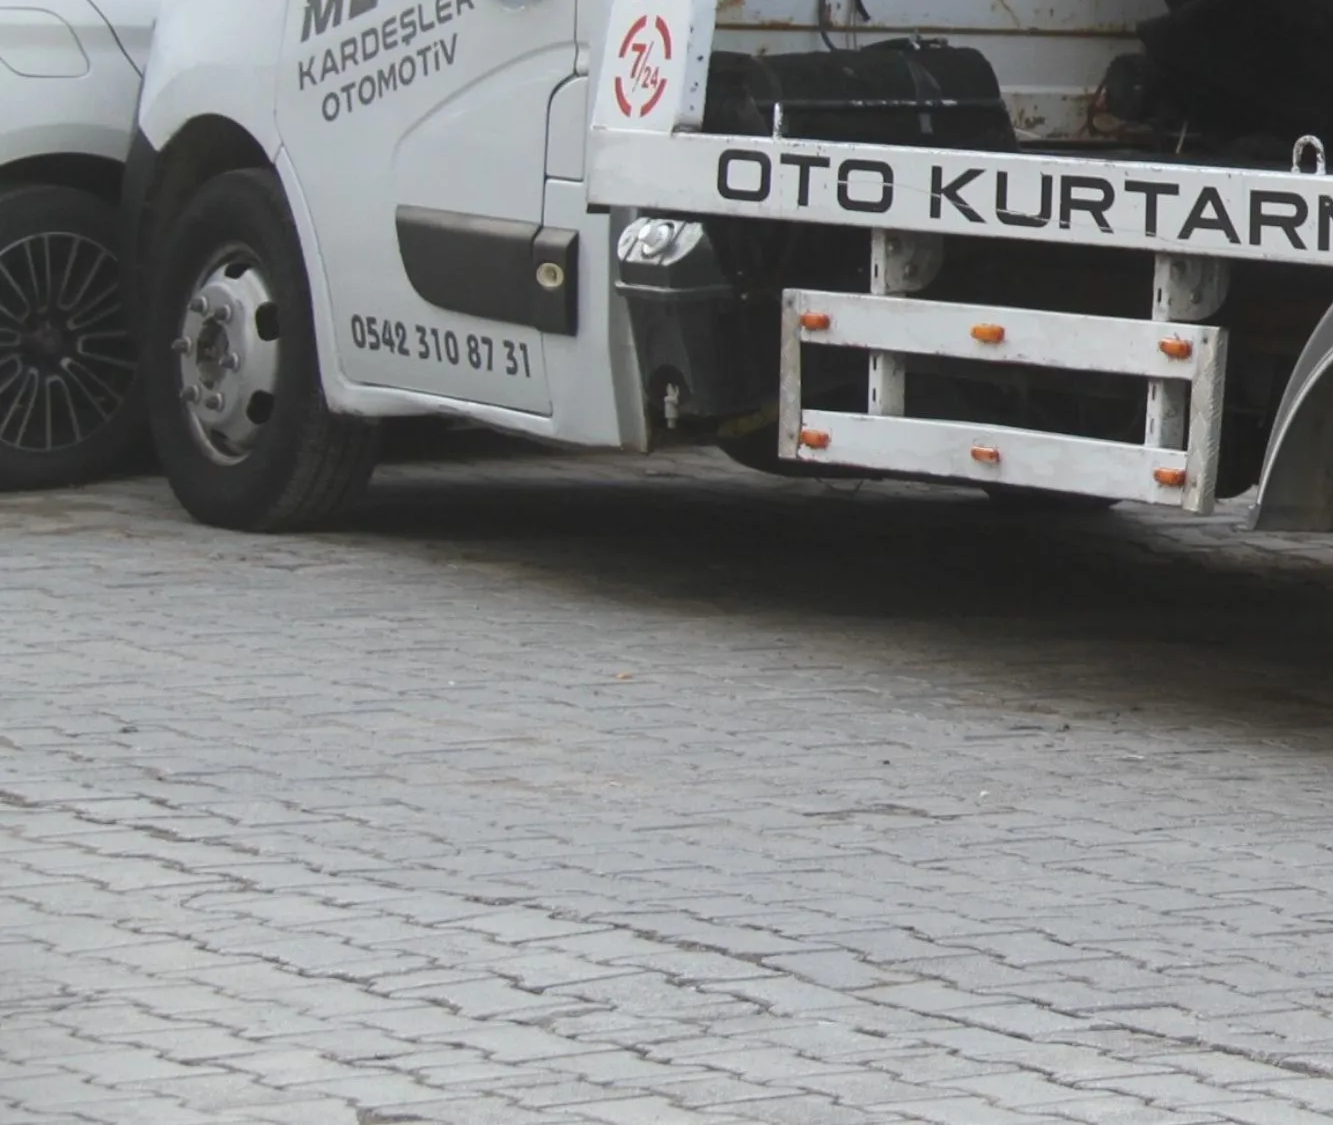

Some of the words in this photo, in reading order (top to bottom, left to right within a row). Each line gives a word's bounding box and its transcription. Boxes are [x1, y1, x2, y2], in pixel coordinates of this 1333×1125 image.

[716, 149, 894, 215] OTO
[352, 315, 408, 356] 0542
[417, 325, 459, 366] 310
[467, 335, 494, 372] 87
[505, 339, 531, 378] 31
